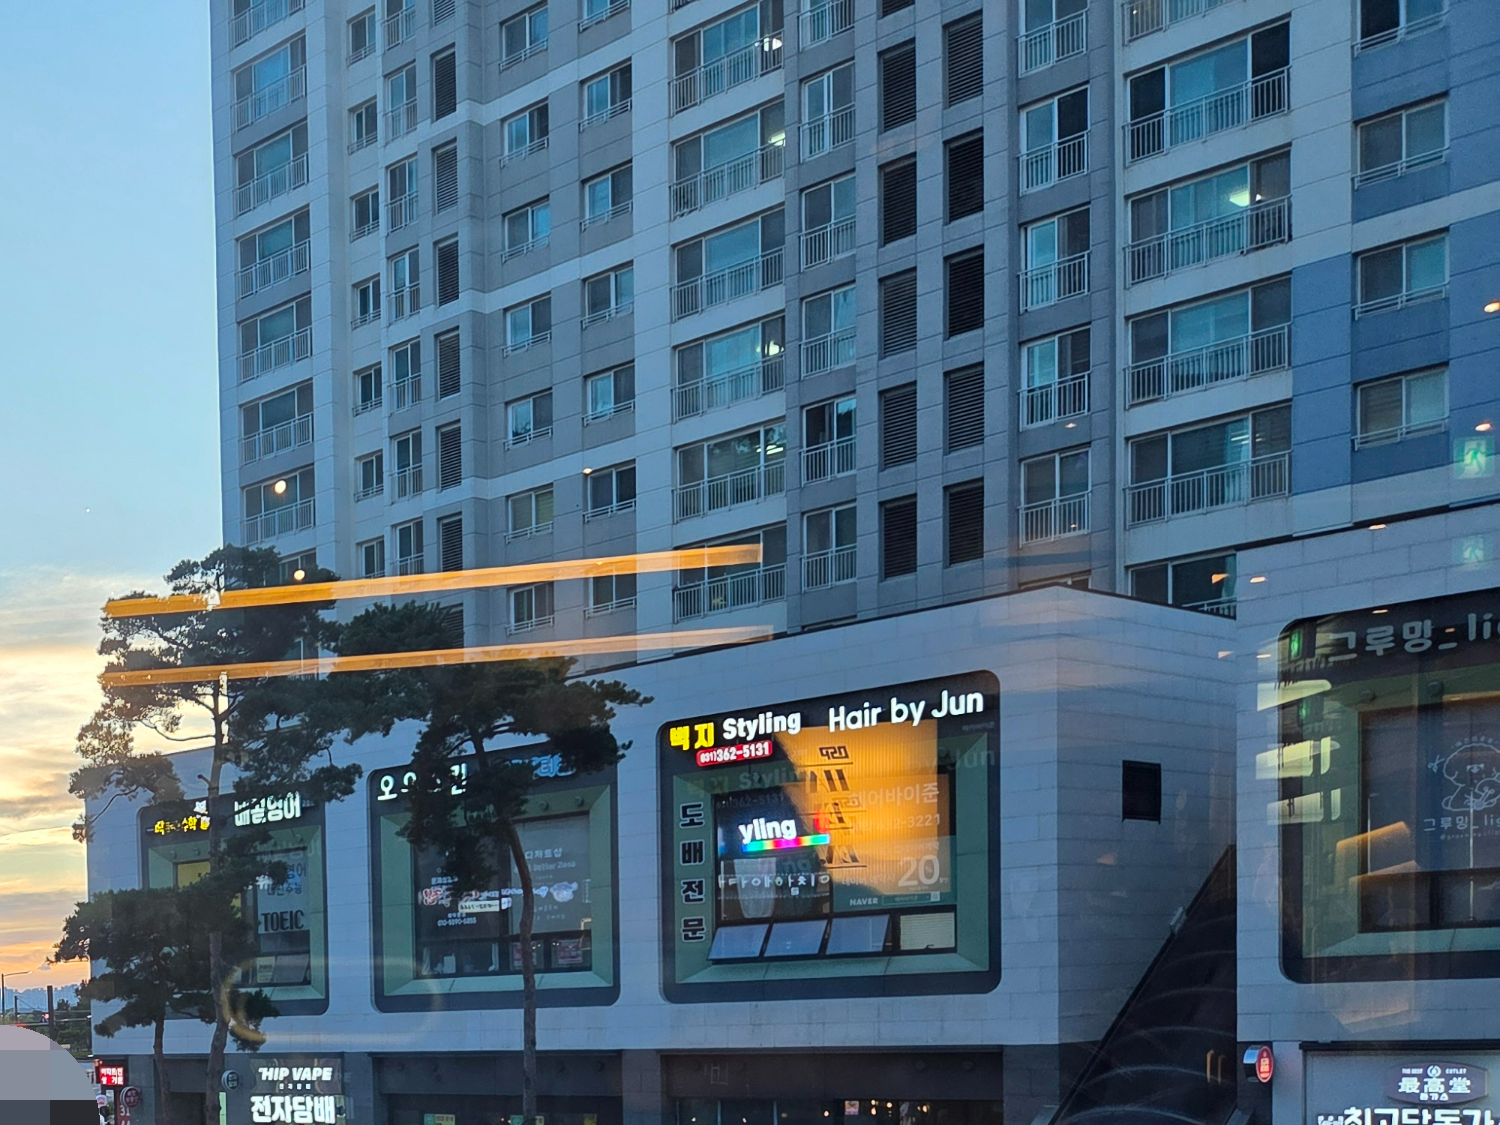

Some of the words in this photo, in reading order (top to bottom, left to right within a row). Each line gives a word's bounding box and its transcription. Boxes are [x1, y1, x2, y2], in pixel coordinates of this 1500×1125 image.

[828, 702, 882, 732] Hair
[890, 697, 926, 727] by
[931, 689, 985, 719] Jun
[722, 711, 801, 741] Styling
[849, 897, 879, 907] NAVER
[260, 909, 305, 932] TOEIC
[258, 1067, 289, 1081] HIP
[291, 1067, 333, 1081] VAPE
[1398, 1076, 1471, 1094] 最高堂
[250, 1094, 337, 1125] 전자담배
